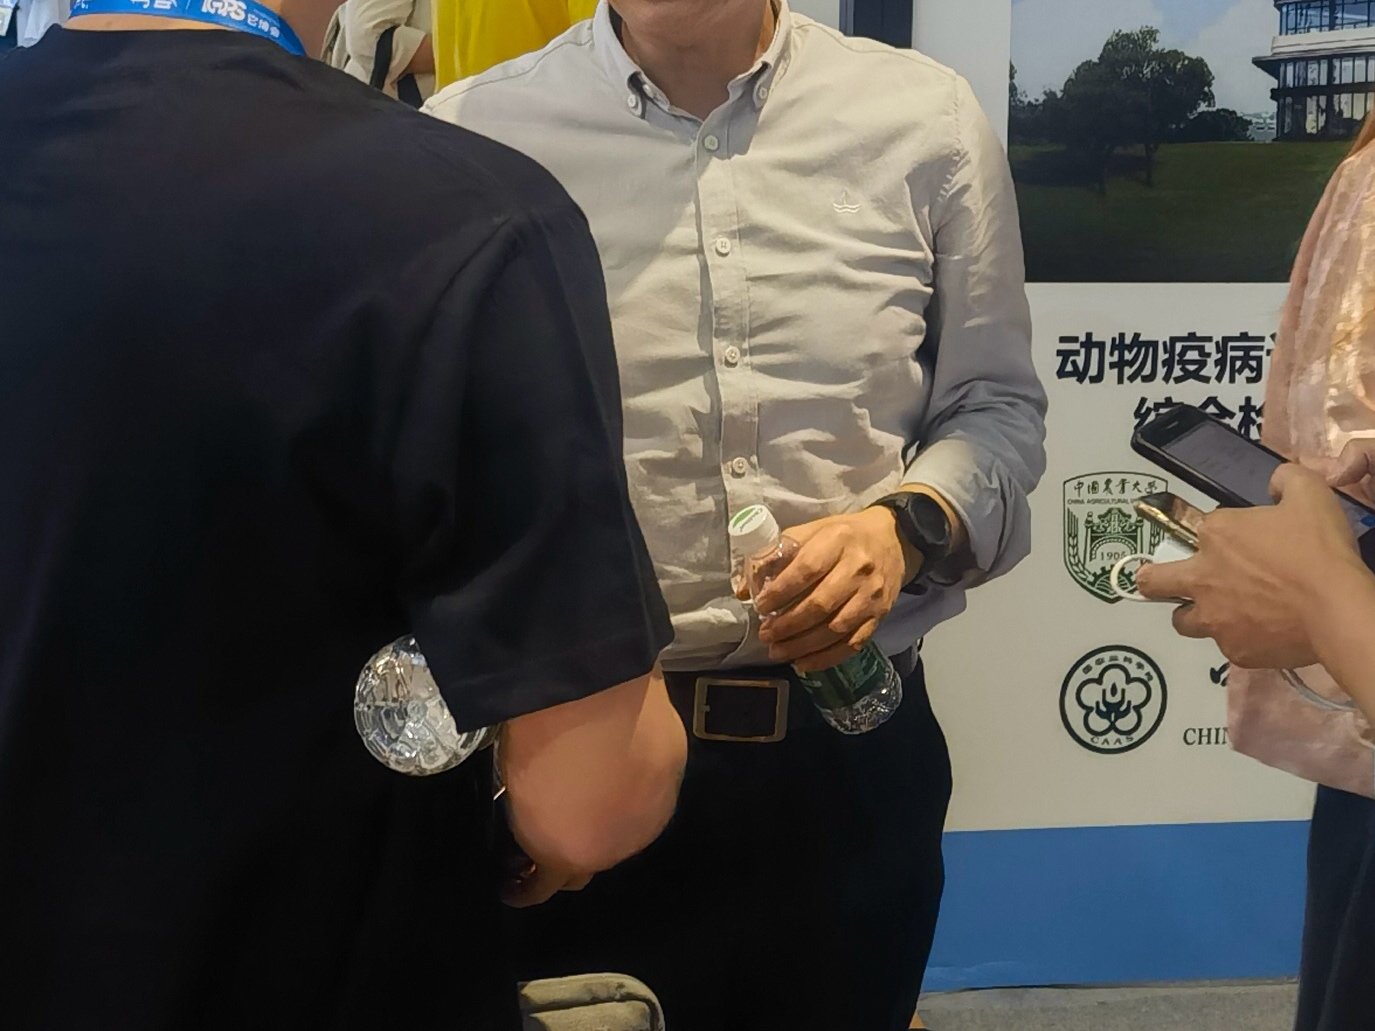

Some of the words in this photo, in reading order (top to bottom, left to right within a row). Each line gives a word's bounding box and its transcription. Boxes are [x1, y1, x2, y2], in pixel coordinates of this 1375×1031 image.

[1056, 332, 1277, 385] 动物疫病
[1090, 735, 1134, 746] CAAS
